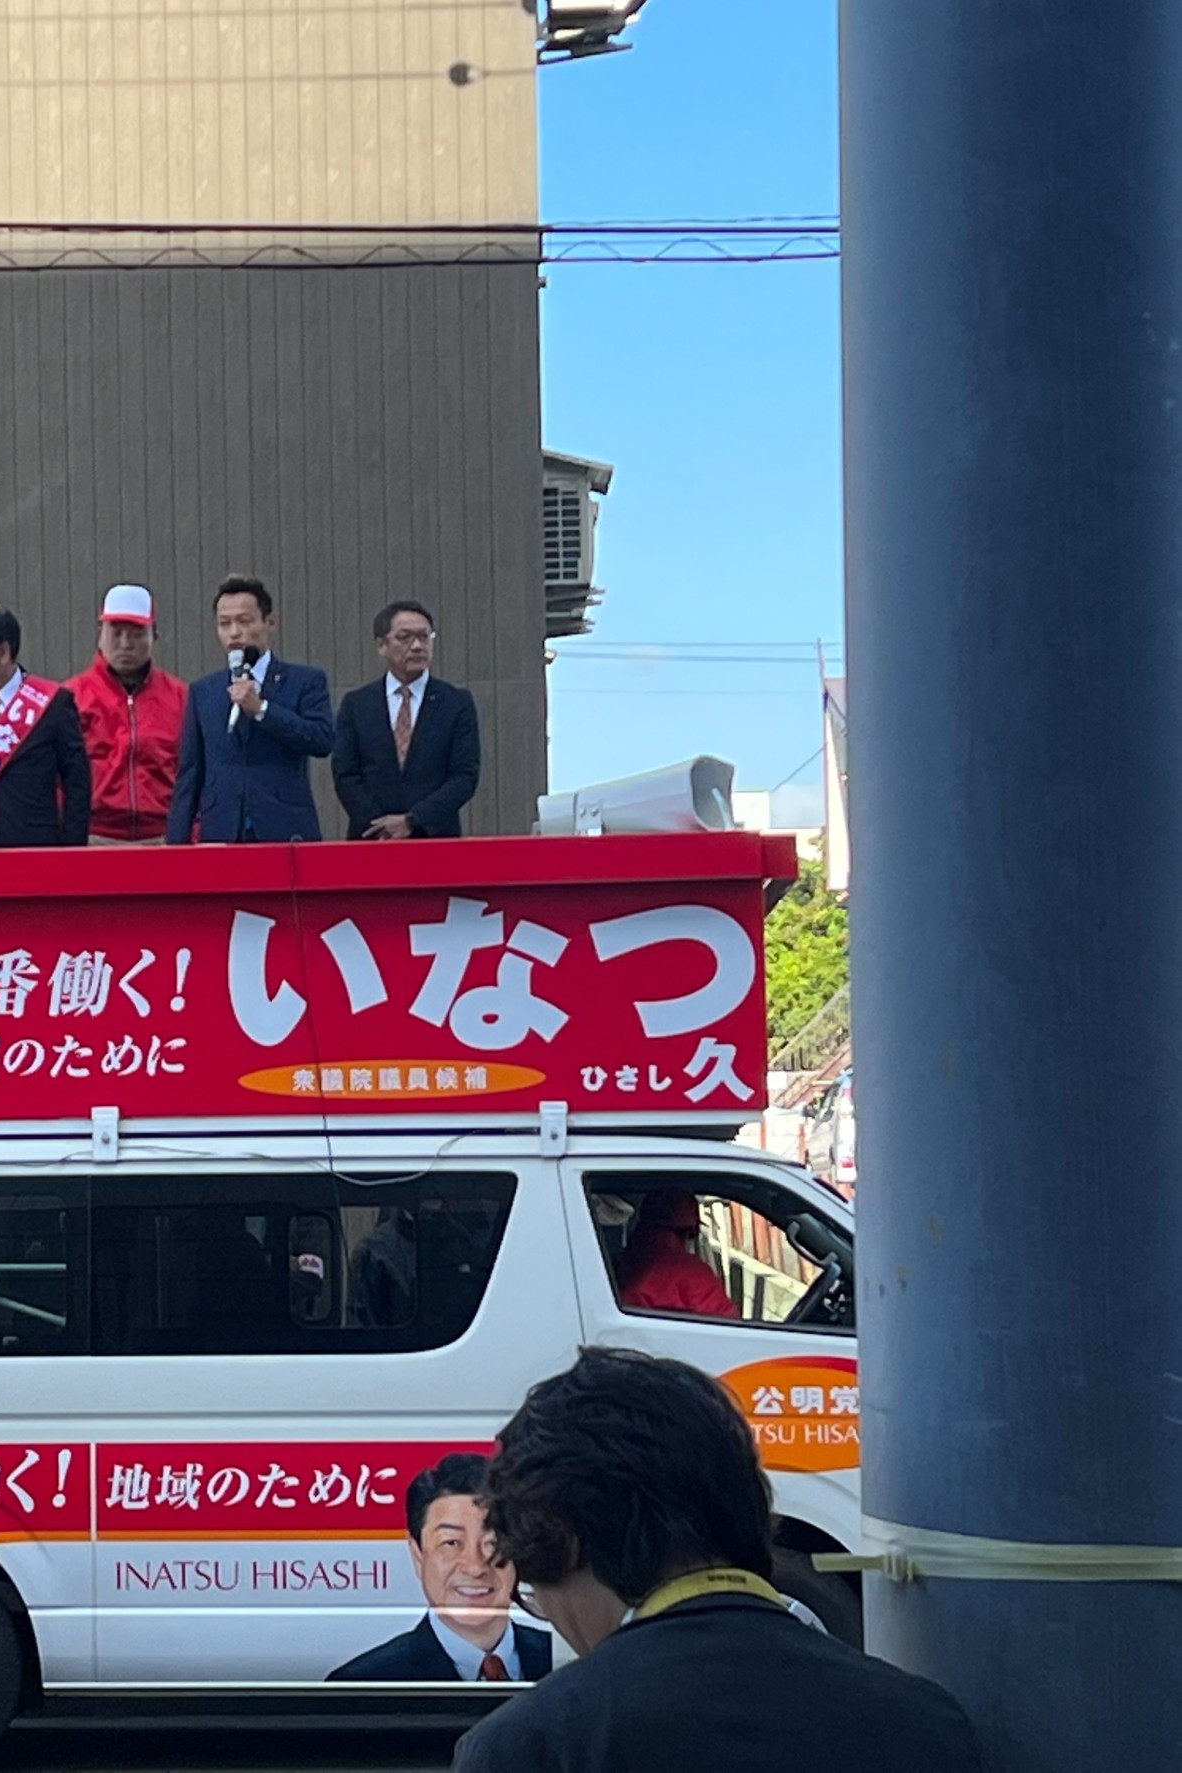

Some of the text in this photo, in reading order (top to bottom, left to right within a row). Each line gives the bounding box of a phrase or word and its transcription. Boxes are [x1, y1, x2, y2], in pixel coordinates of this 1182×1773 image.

[227, 896, 757, 1051] いなつ
[291, 1066, 487, 1092] 衆議院議員候補
[580, 1065, 673, 1092] ひさし
[683, 1037, 755, 1102] 久
[751, 1385, 860, 1415] 公明党
[750, 1424, 860, 1444] TSU HISA
[105, 1462, 397, 1511] 地域のために
[116, 1560, 389, 1590] INATSU HISASHI
